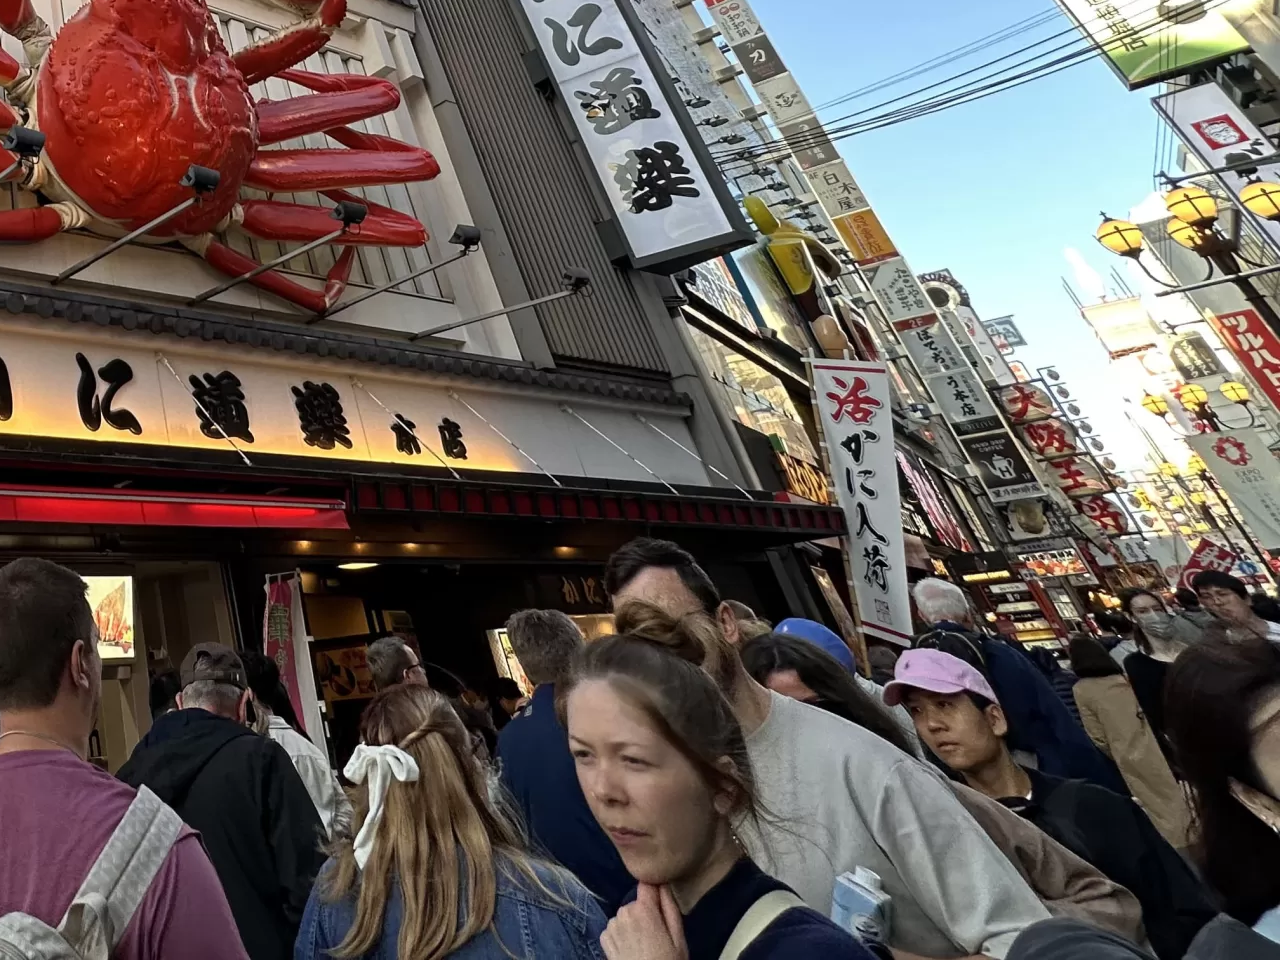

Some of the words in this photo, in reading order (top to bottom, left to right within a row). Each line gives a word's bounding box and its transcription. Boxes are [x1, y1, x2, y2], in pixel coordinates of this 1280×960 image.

[822, 171, 858, 211] 白木屋
[908, 318, 924, 328] 2F
[978, 445, 1004, 453] COFFEE
[1235, 469, 1260, 478] EXPO
[826, 375, 889, 592] 活かに入荷
[1240, 475, 1264, 484] 2025
